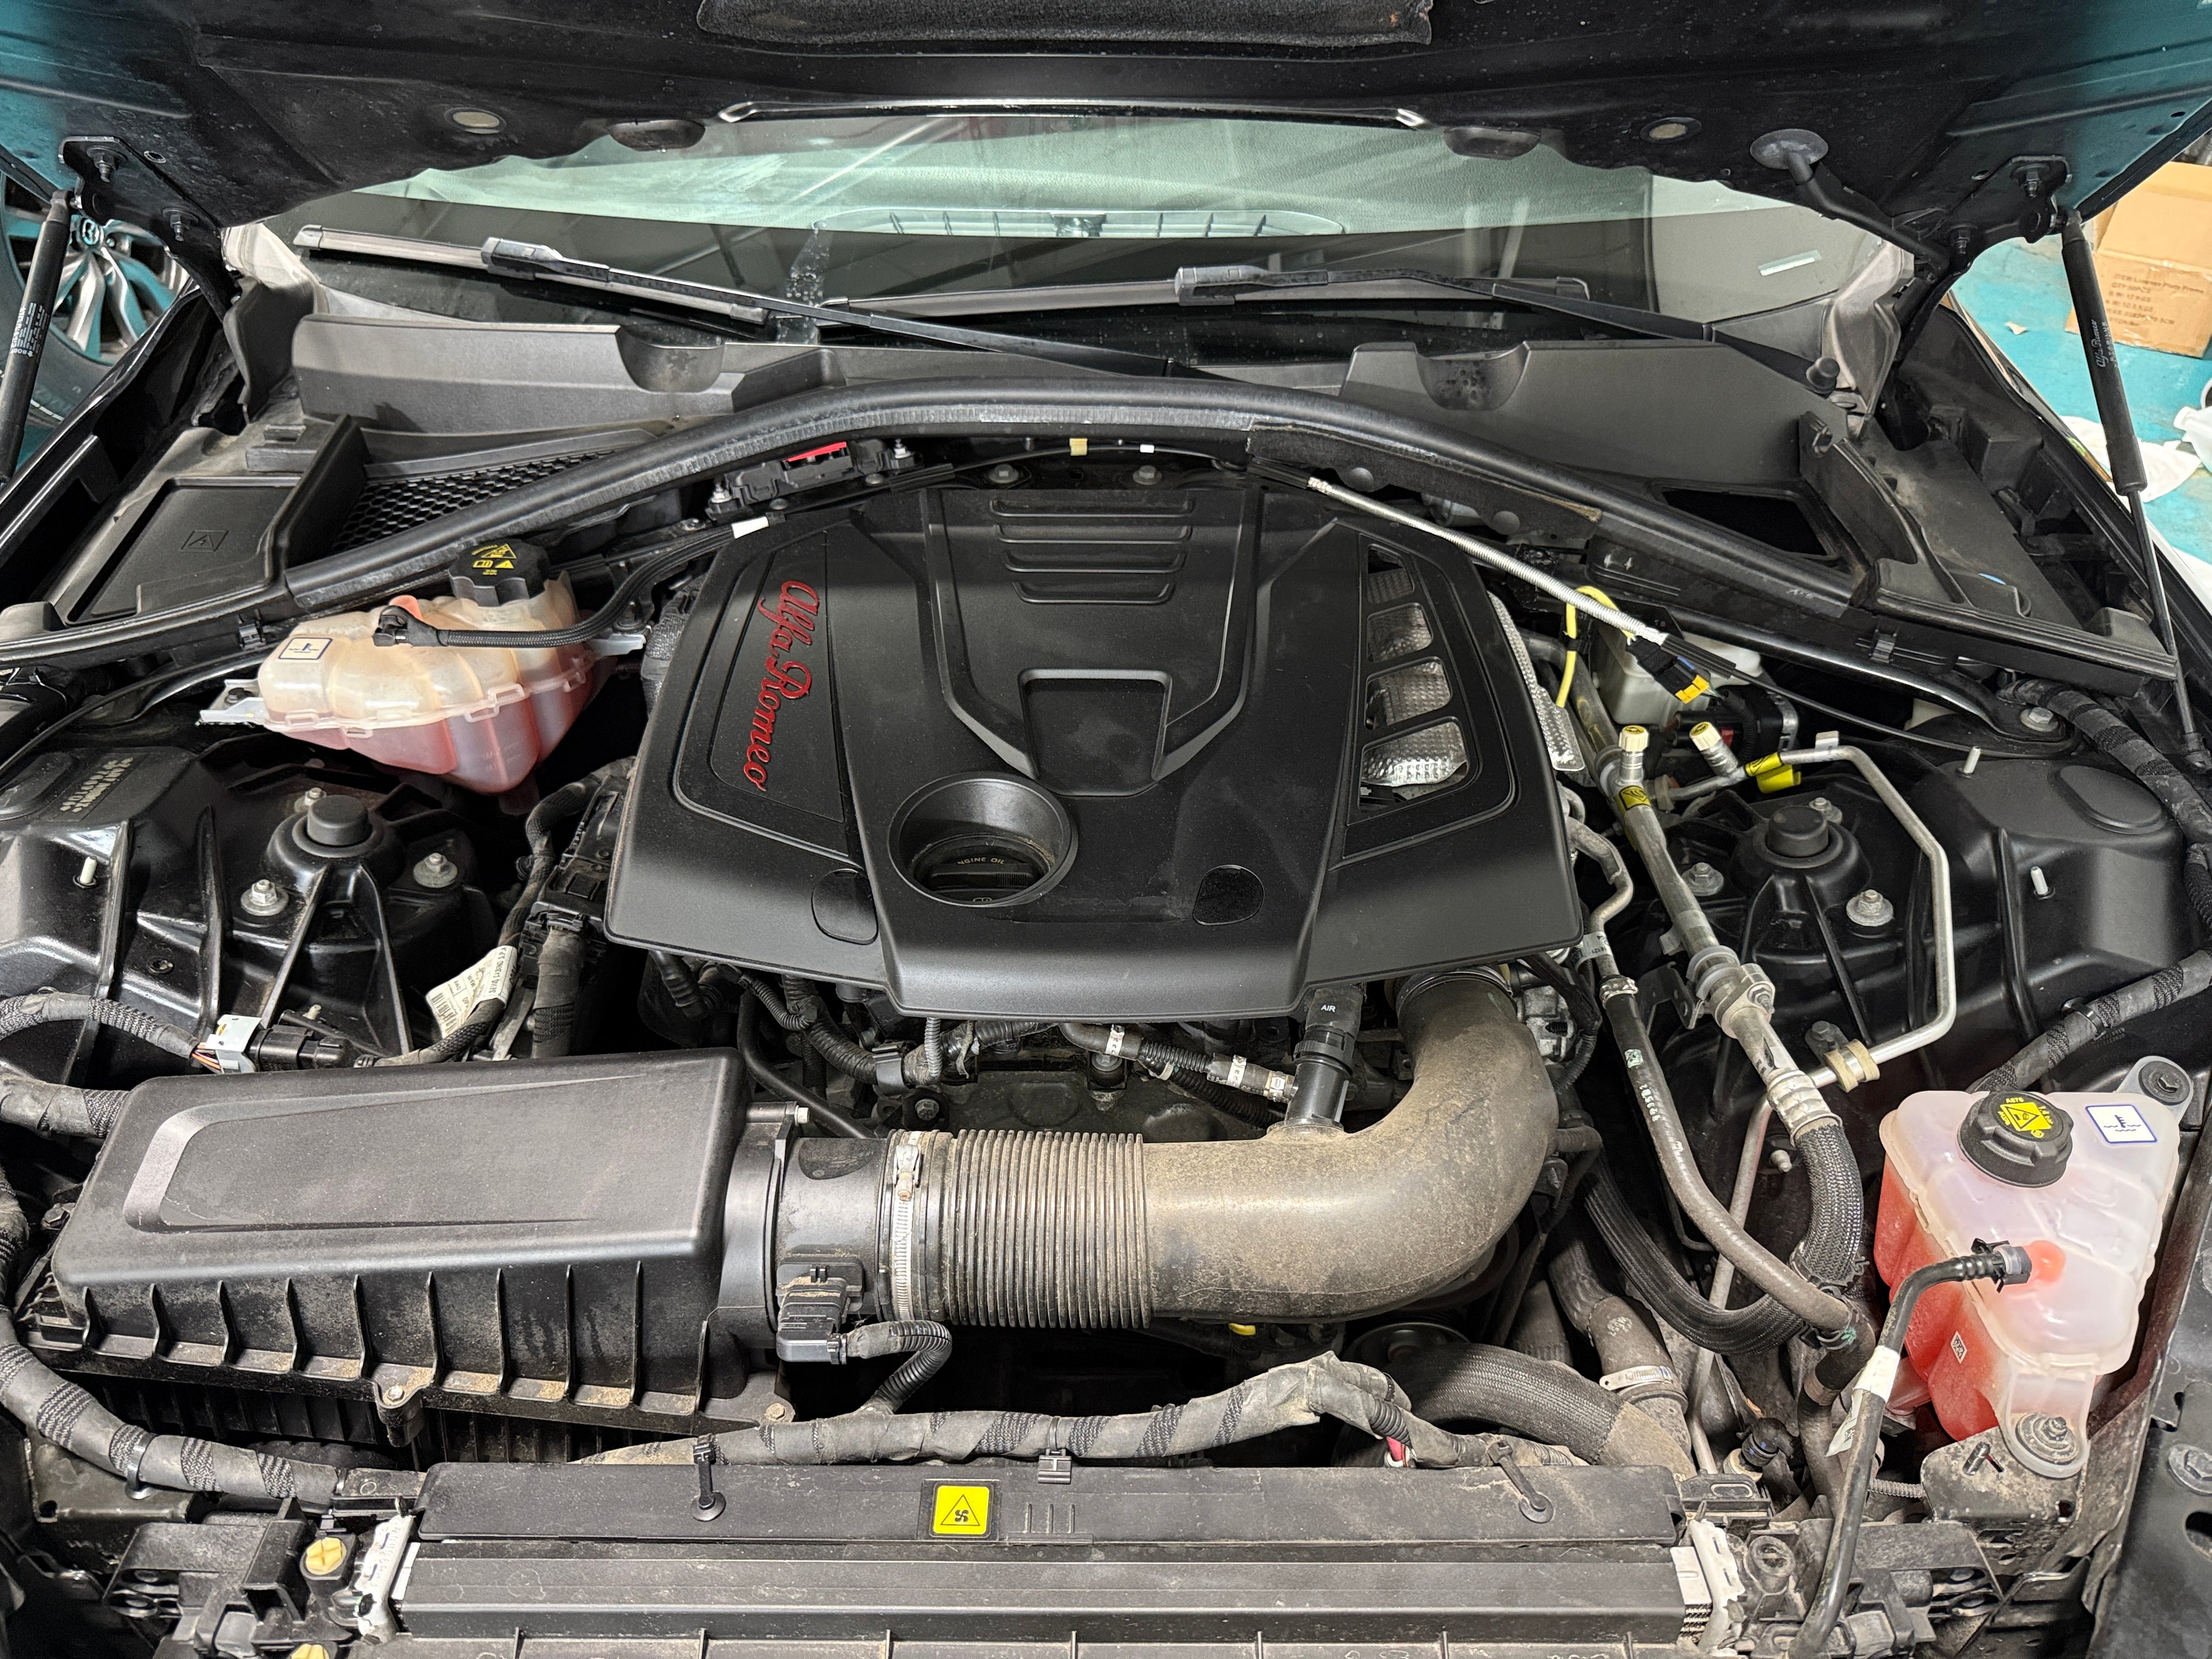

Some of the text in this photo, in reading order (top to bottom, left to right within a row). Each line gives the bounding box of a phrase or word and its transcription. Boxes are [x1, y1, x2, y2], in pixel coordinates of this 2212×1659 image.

[743, 579, 820, 792] Alfa Romeo
[1321, 1005, 1336, 1013] AIR
